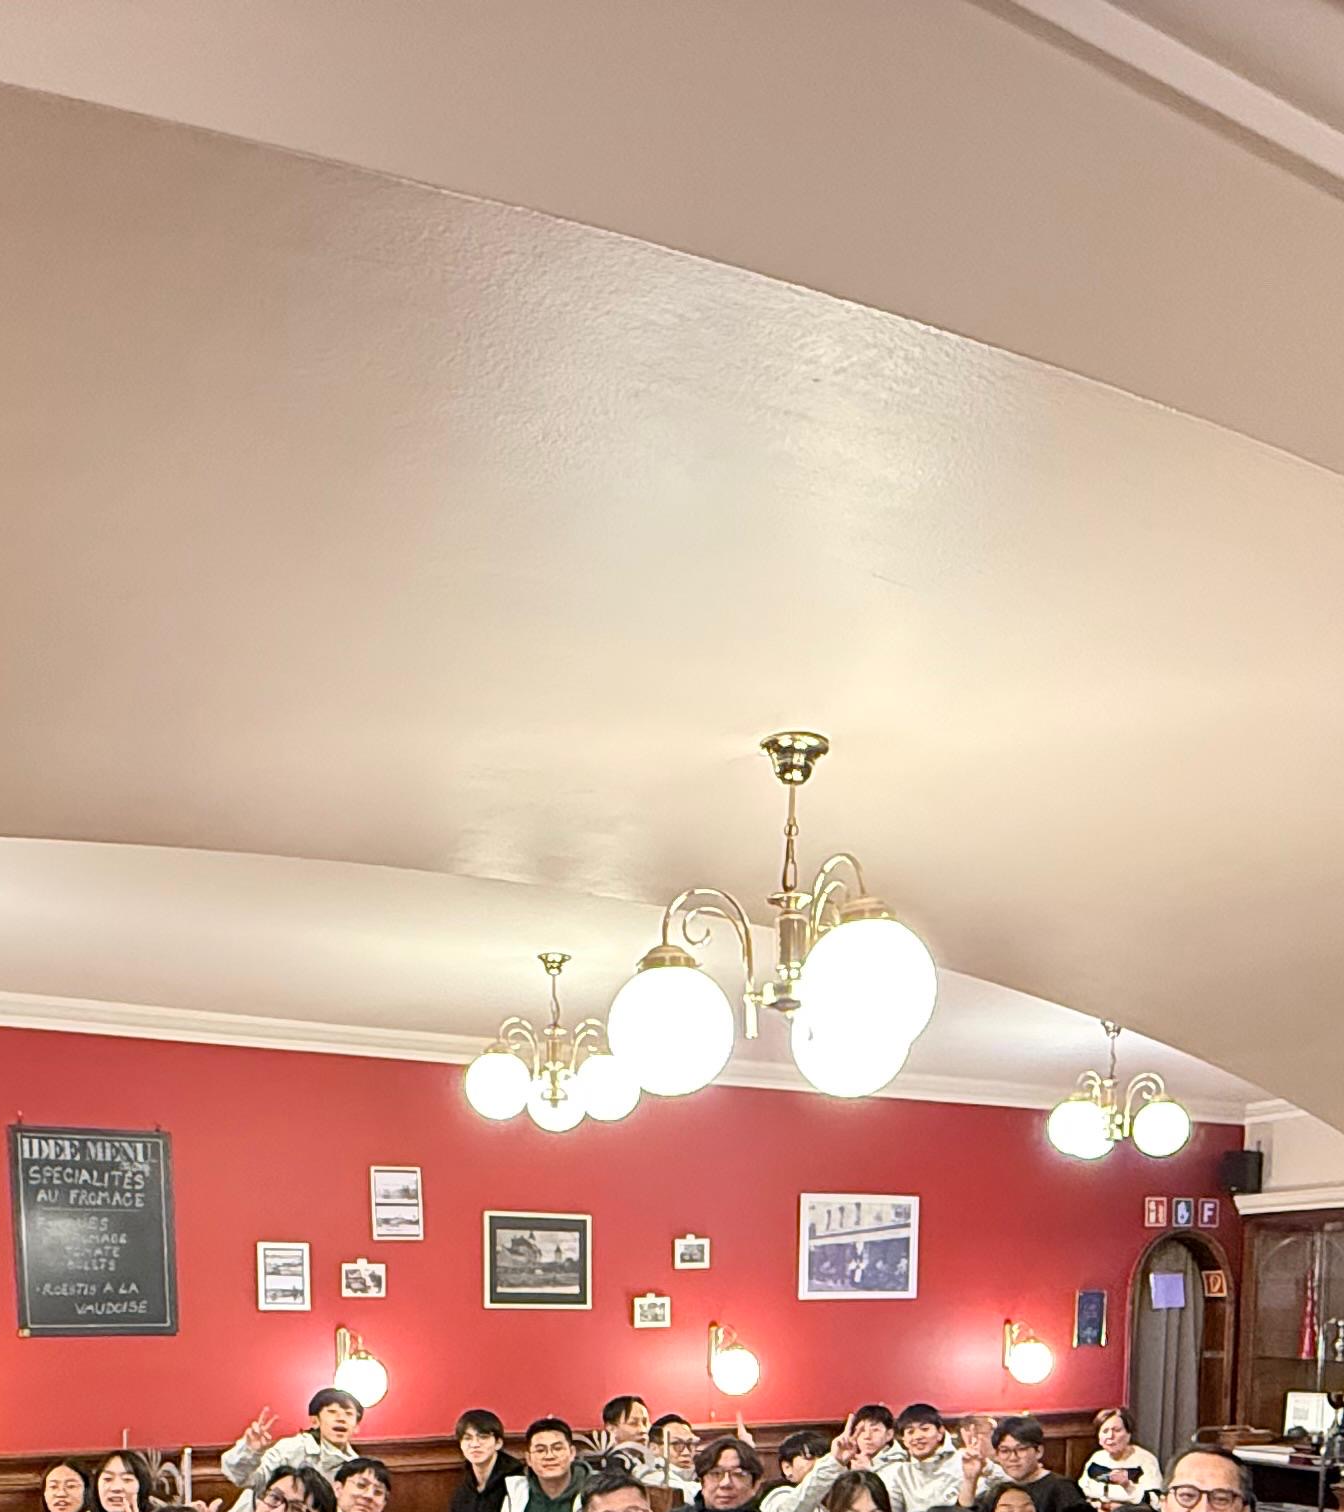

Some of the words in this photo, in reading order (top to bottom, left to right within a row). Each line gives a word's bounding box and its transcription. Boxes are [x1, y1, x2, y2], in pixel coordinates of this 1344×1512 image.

[22, 1138, 80, 1160] IDEE
[87, 1142, 153, 1162] MENU
[36, 1189, 59, 1202] AU
[69, 1190, 145, 1208] FROMAGE
[1203, 1203, 1215, 1223] F
[119, 1282, 139, 1294] LA
[74, 1300, 148, 1315] VAUDOISE
